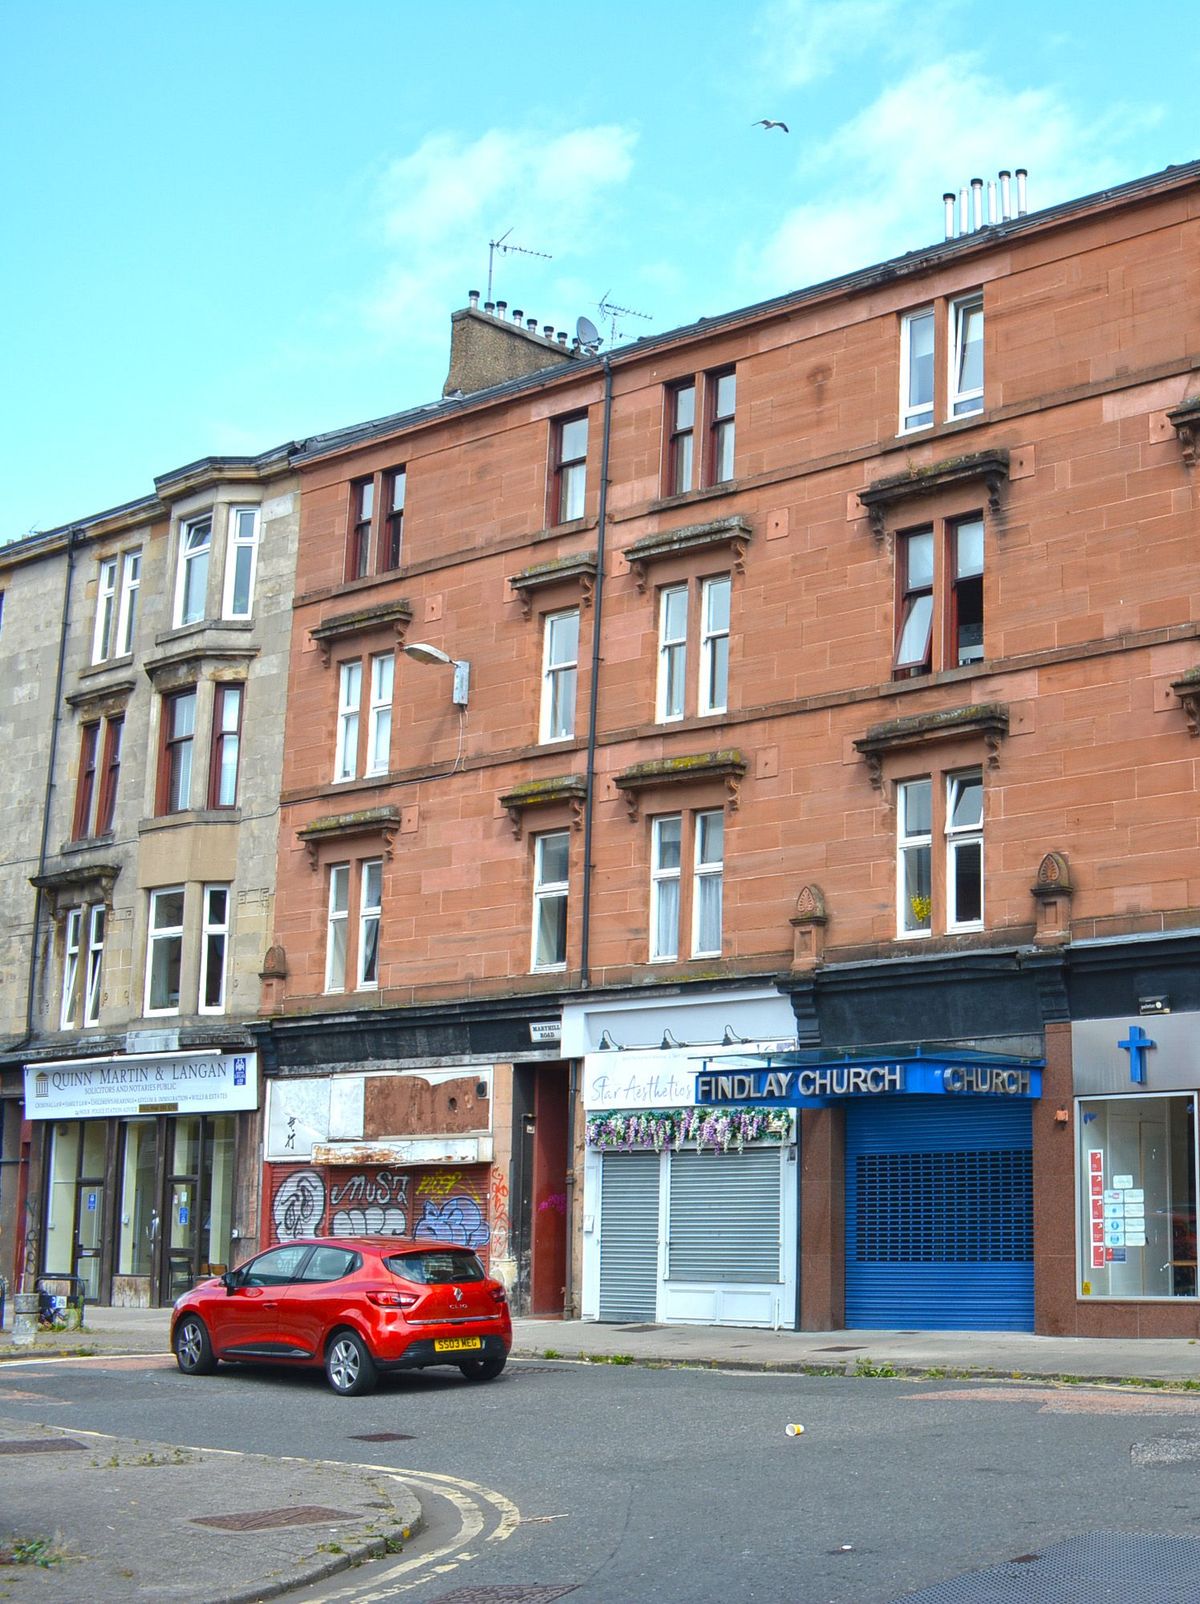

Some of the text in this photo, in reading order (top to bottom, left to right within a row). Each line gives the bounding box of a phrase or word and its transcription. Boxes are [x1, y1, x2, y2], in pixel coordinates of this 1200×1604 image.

[532, 1024, 561, 1033] MARYHILL
[540, 1031, 555, 1039] ROAD
[52, 1071, 92, 1091] QUINN
[100, 1067, 149, 1085] MARTIN
[155, 1065, 164, 1081] &
[172, 1062, 227, 1080] LANGAN
[697, 1065, 904, 1100] FINDLAY CHURCH
[943, 1067, 1031, 1094] CHURCH
[84, 1082, 177, 1095] SOLICITORS AND NOTARIES PUBLIC
